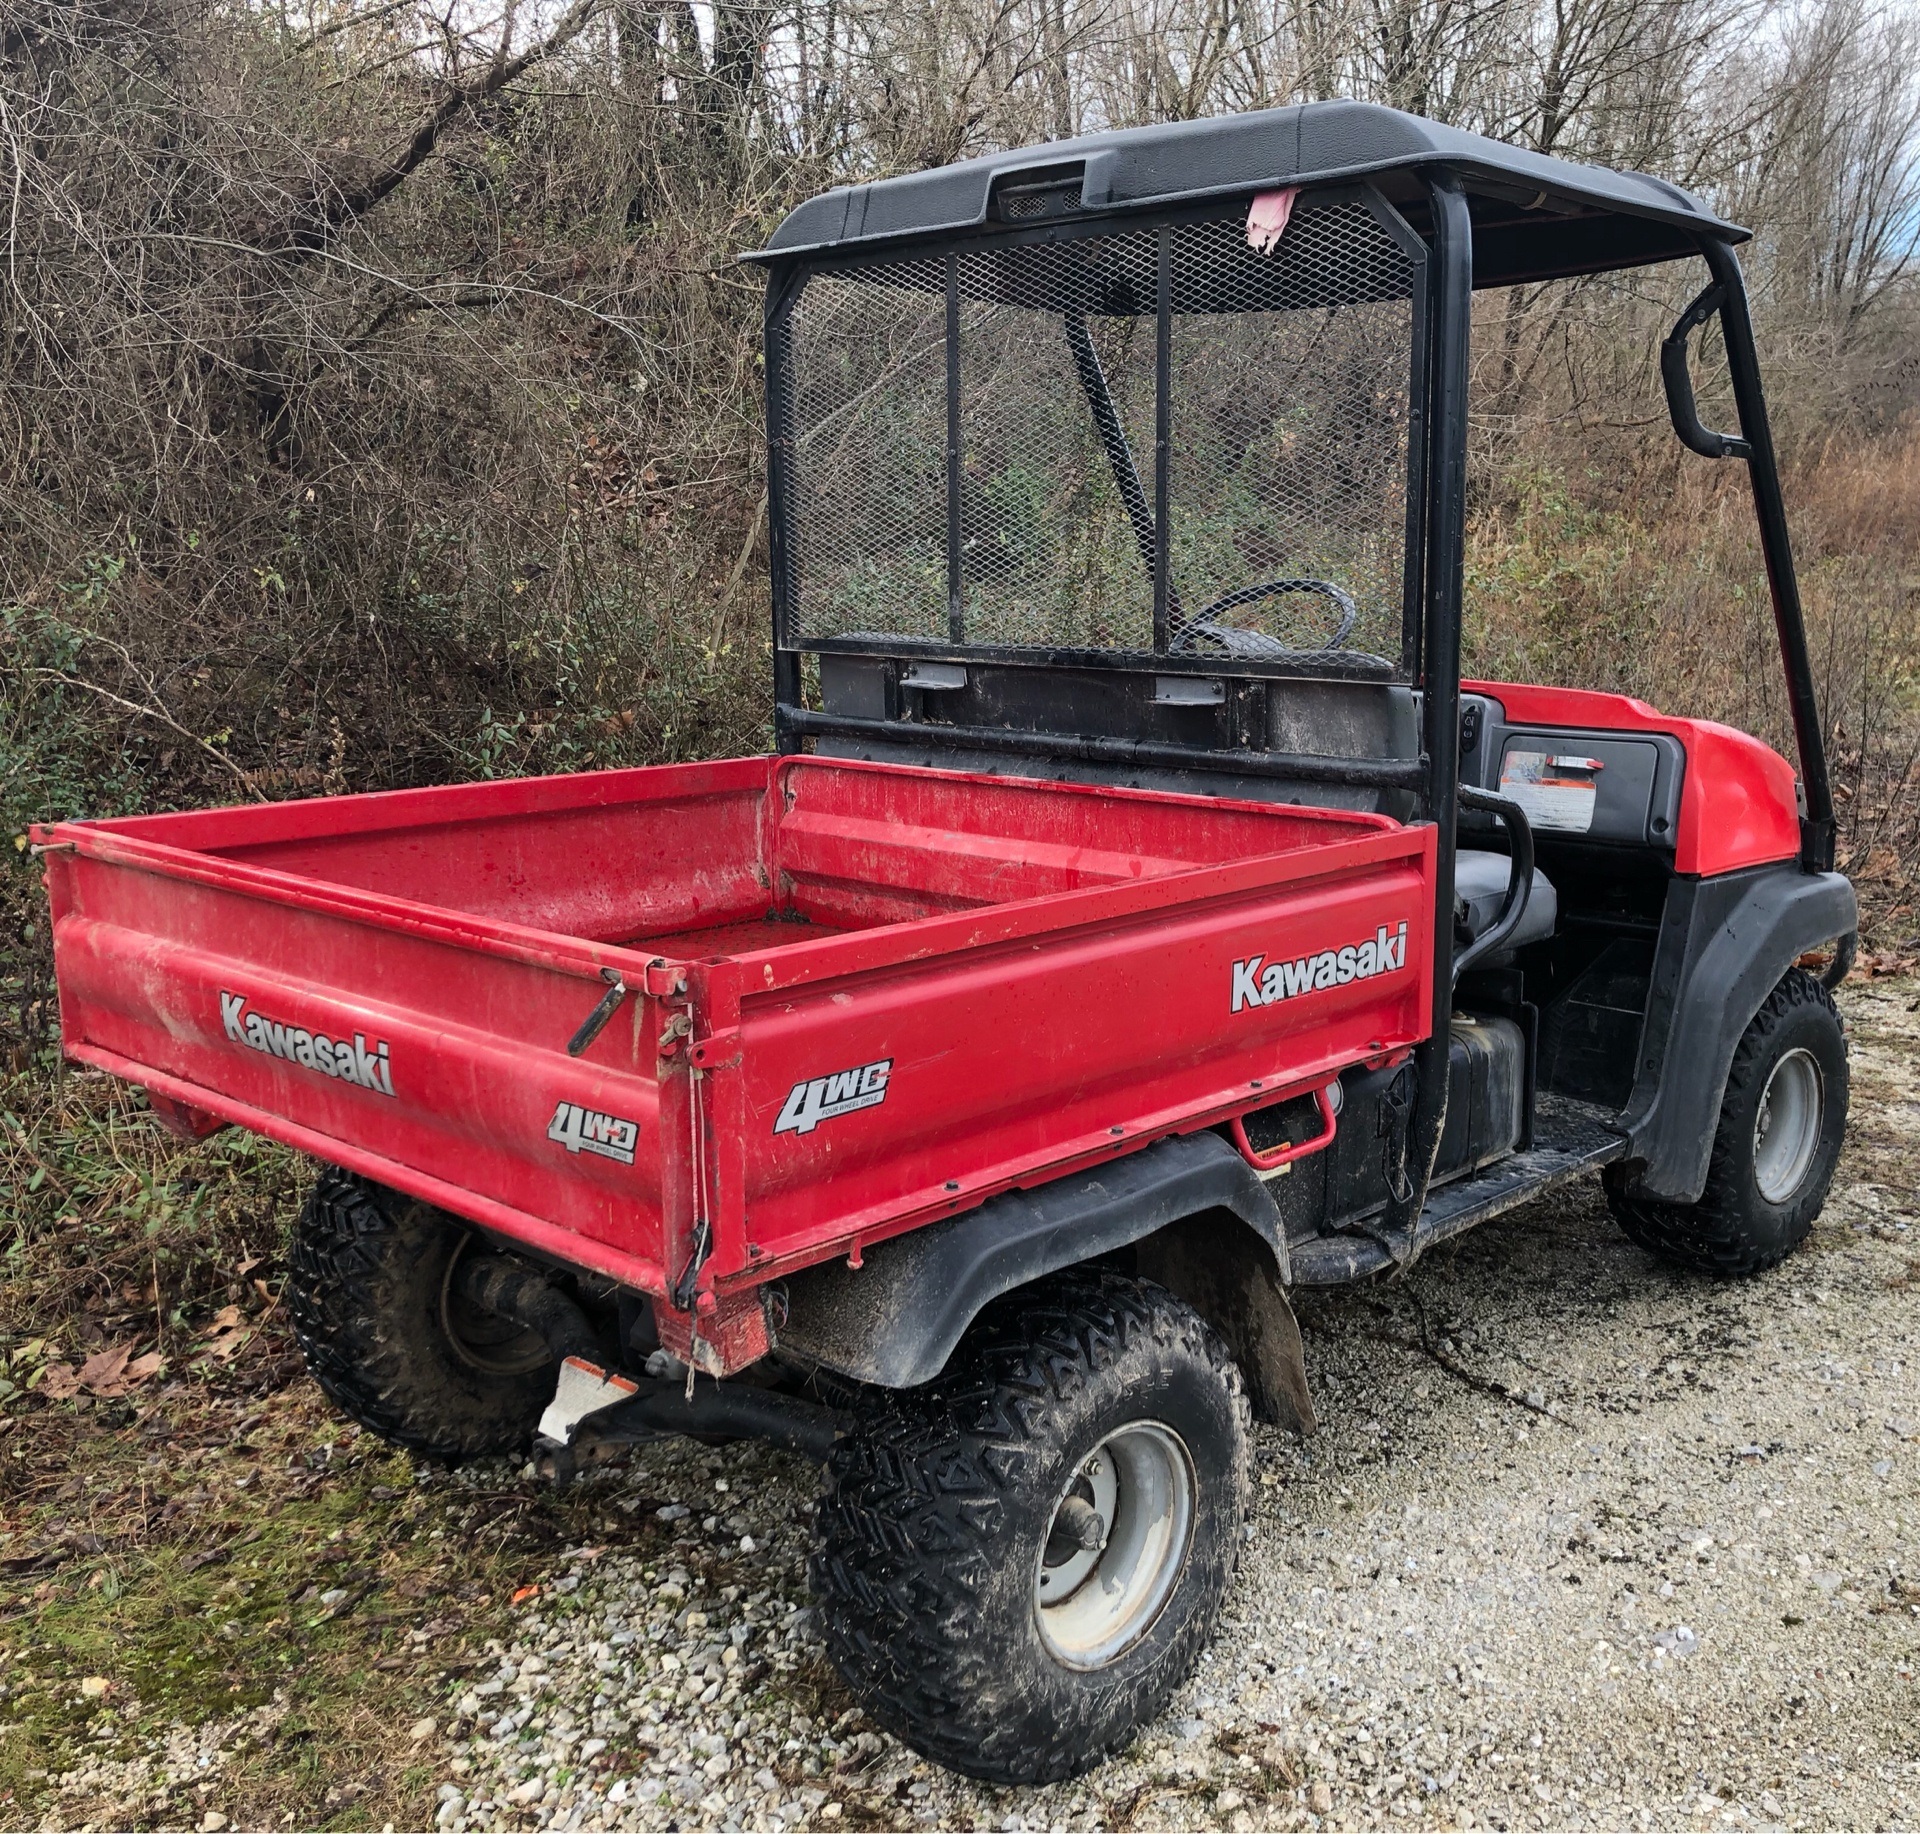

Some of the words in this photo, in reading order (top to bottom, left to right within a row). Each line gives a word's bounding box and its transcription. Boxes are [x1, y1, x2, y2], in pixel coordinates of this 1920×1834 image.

[1230, 920, 1408, 1014] Kawasaki
[220, 990, 397, 1097] Kawasaki
[547, 1101, 639, 1154] 4WD
[773, 1060, 892, 1135] 4WD
[821, 1105, 839, 1116] FOUR
[840, 1100, 859, 1111] WHEEL
[861, 1094, 879, 1105] DRIVE
